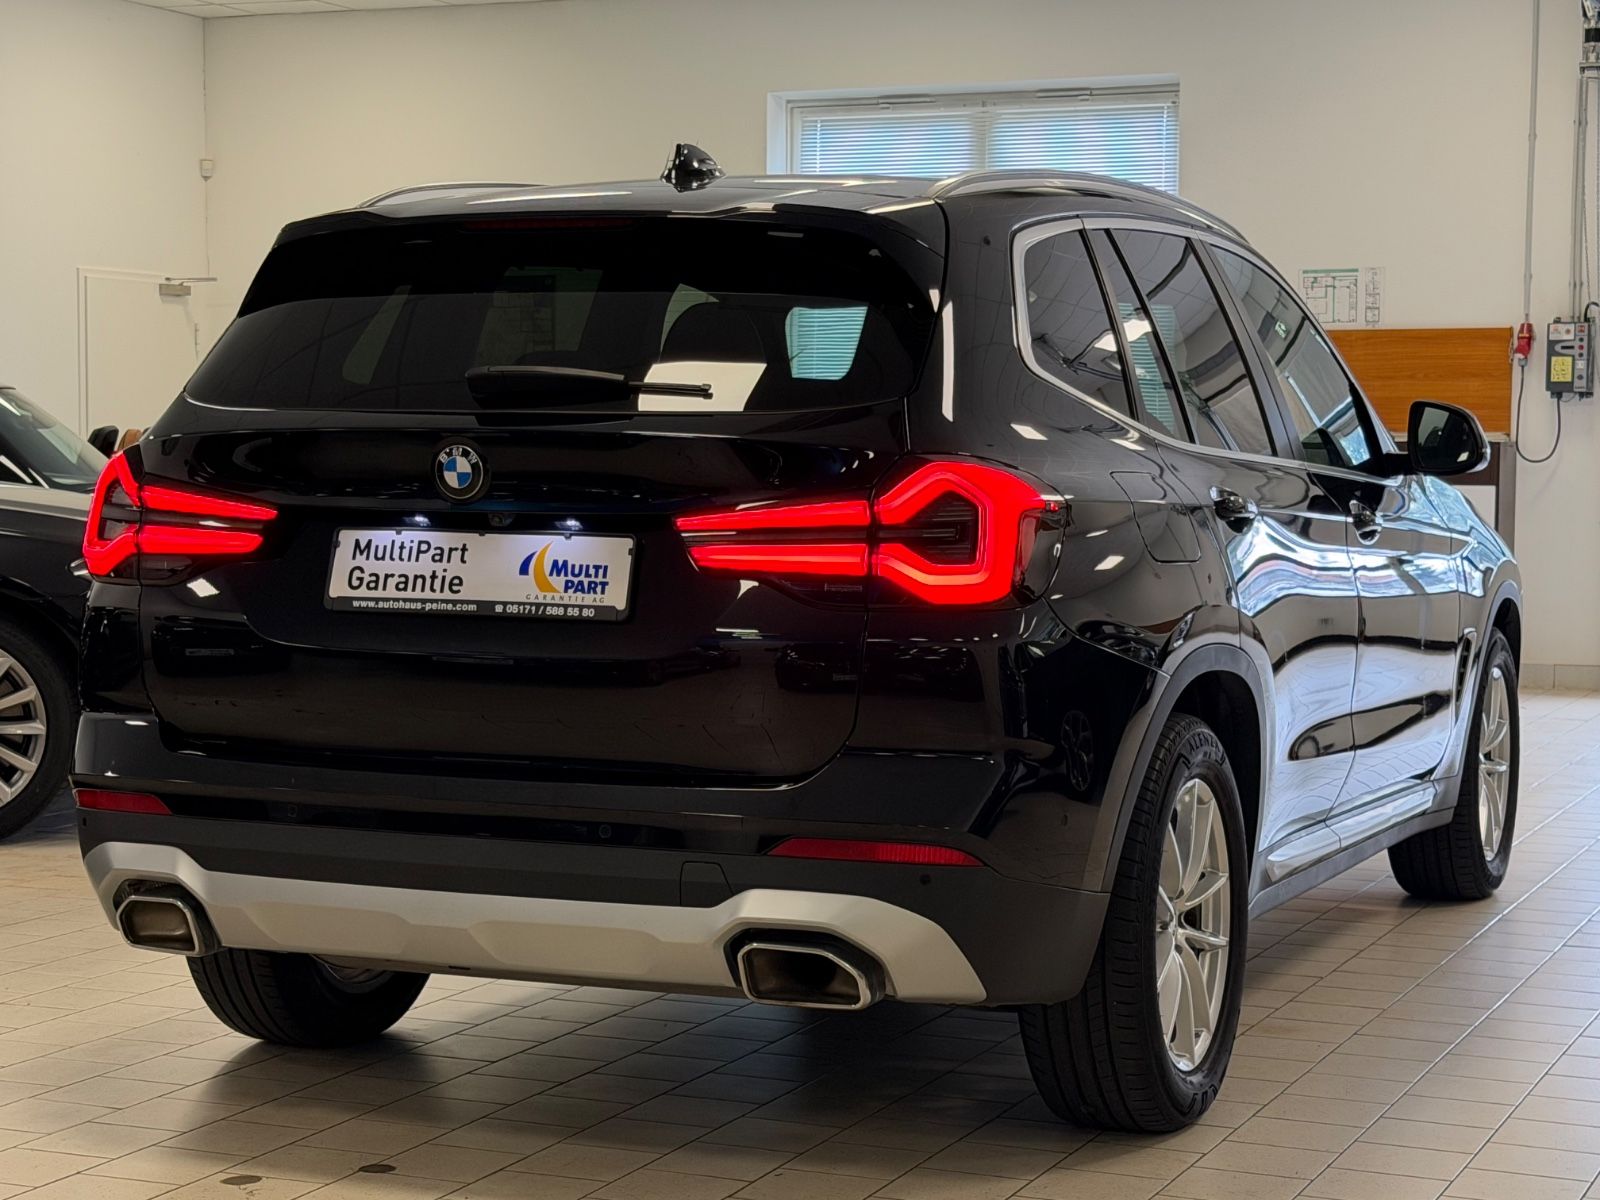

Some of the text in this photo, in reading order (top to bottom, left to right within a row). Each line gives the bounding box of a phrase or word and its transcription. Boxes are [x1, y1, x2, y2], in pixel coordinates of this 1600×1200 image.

[438, 447, 478, 465] BMW
[352, 538, 469, 564] MultiPart
[549, 559, 609, 579] MULTI
[347, 566, 464, 594] Garantie
[563, 579, 609, 595] PART
[352, 600, 477, 612] www.autohaus-peine.com
[525, 594, 585, 603] GARANTIE
[506, 605, 536, 614] 05171
[545, 606, 564, 615] 588
[566, 606, 580, 616] 55
[581, 607, 595, 617] 80
